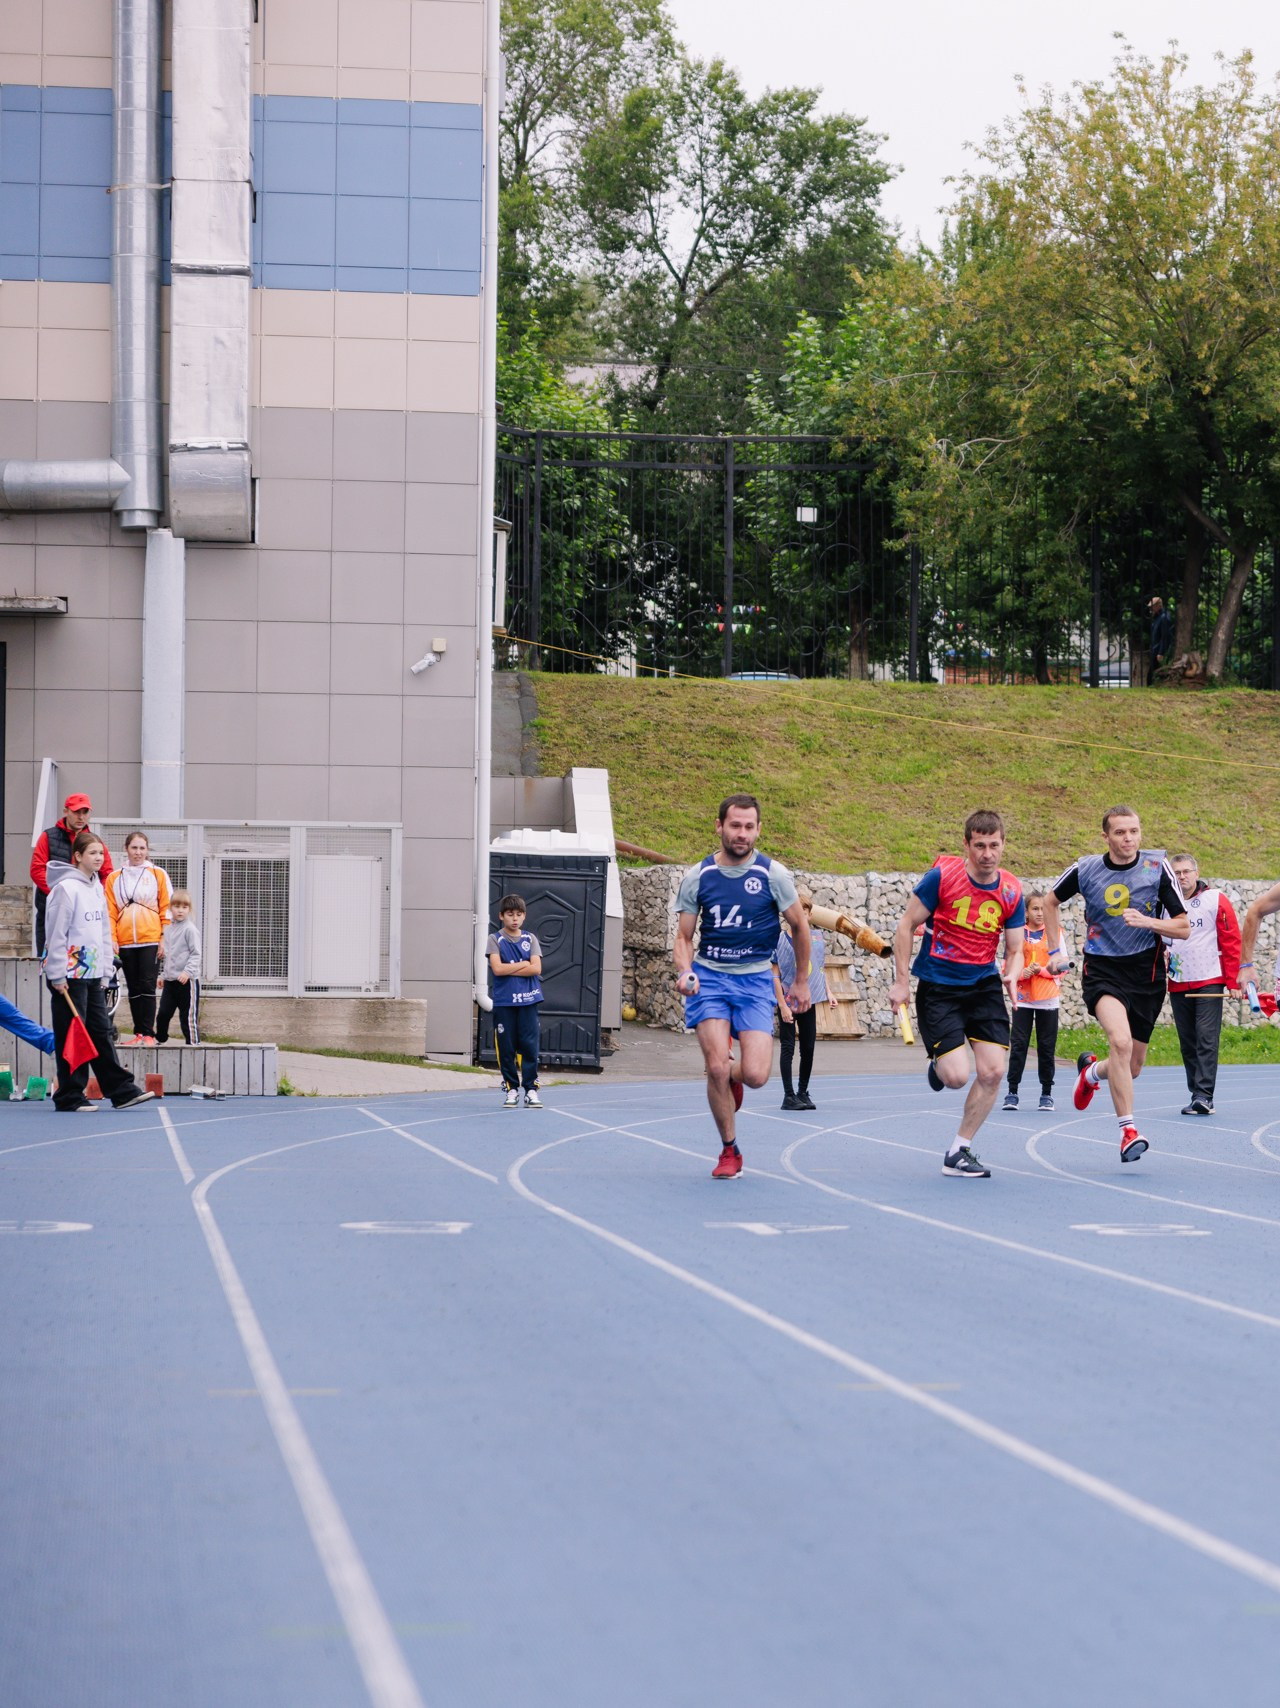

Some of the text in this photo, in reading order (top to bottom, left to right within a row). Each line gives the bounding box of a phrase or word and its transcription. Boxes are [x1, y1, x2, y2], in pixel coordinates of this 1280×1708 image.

[709, 904, 743, 929] 14
[948, 895, 1003, 933] 18
[1104, 883, 1131, 917] 9
